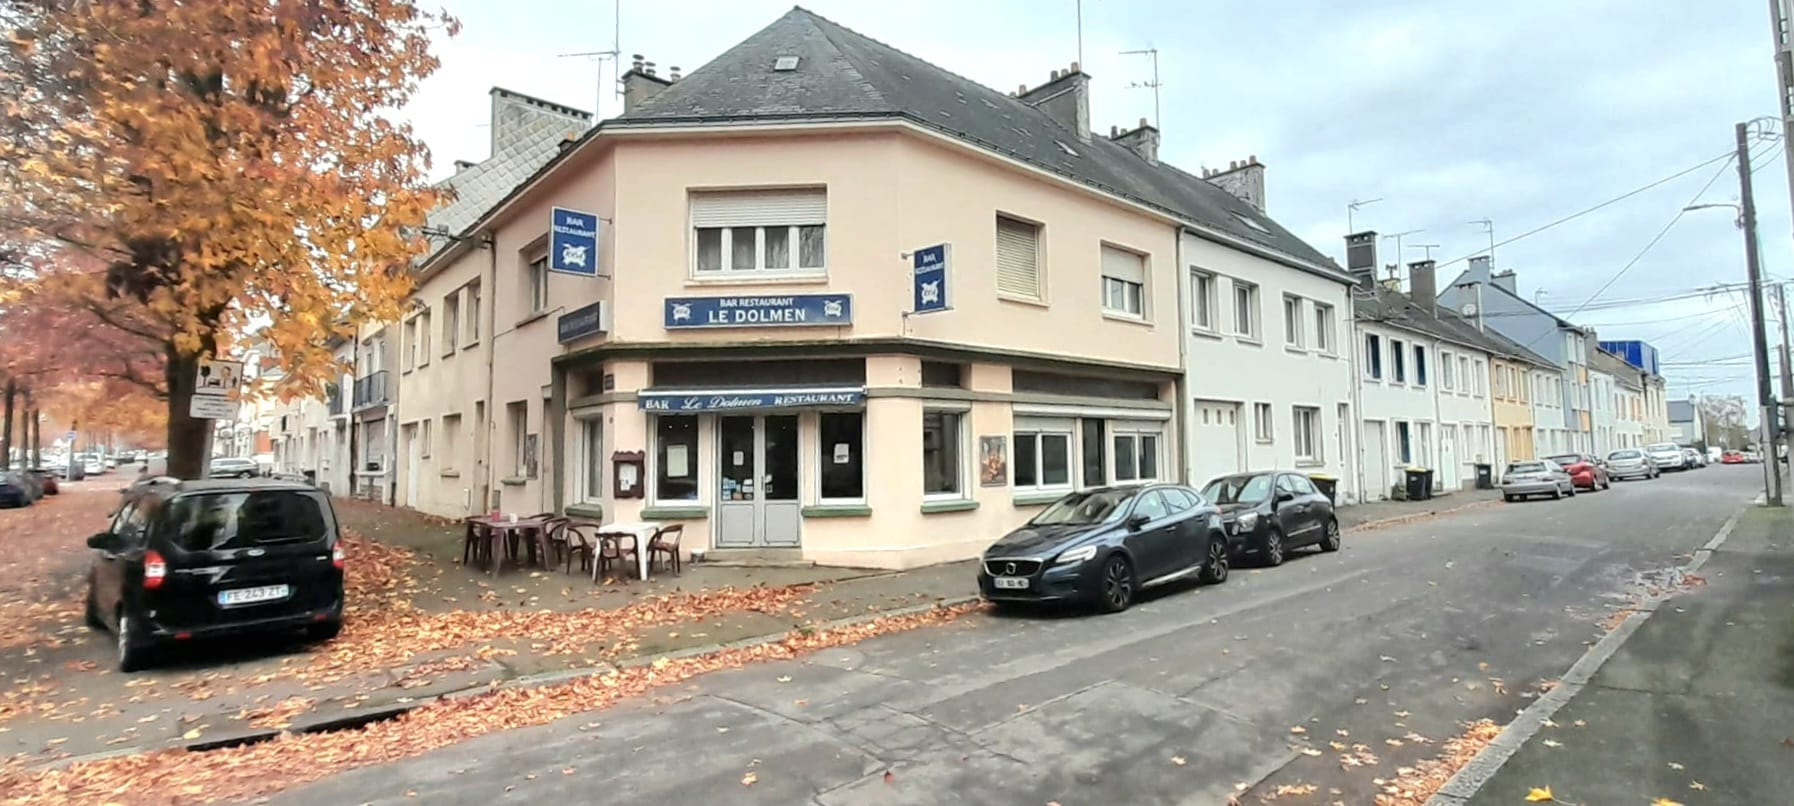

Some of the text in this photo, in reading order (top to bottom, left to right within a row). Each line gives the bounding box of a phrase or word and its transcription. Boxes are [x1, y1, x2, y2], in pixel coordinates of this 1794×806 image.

[566, 216, 584, 228] BAR
[923, 253, 937, 264] BAR
[720, 297, 794, 307] BAR RESTAURANT
[708, 308, 806, 323] LE DOLMEN
[645, 393, 855, 410] BAR Le Dolmen RESTAURANT
